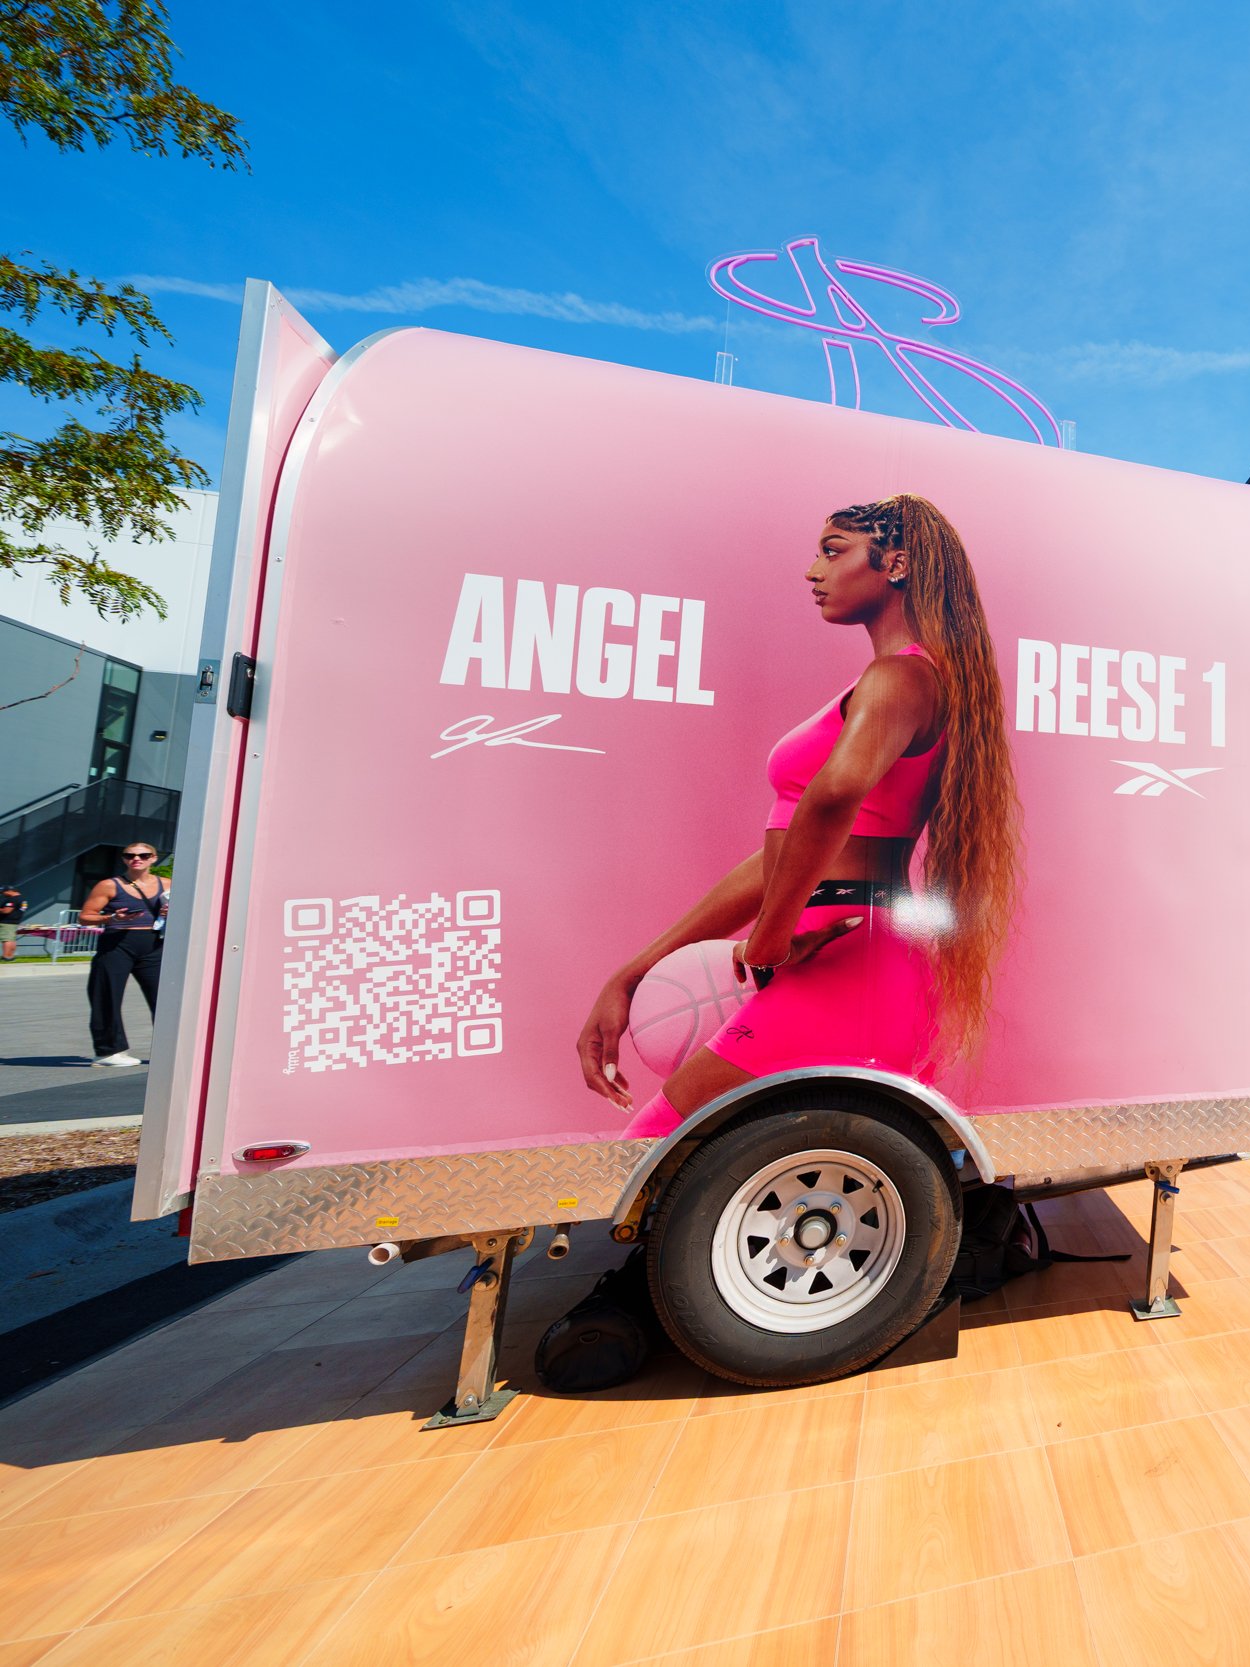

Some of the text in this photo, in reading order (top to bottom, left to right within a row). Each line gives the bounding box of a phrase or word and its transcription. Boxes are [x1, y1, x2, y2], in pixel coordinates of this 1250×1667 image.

[439, 573, 715, 706] ANGEL
[1016, 638, 1227, 748] REESE 1
[282, 1049, 300, 1075] bitly
